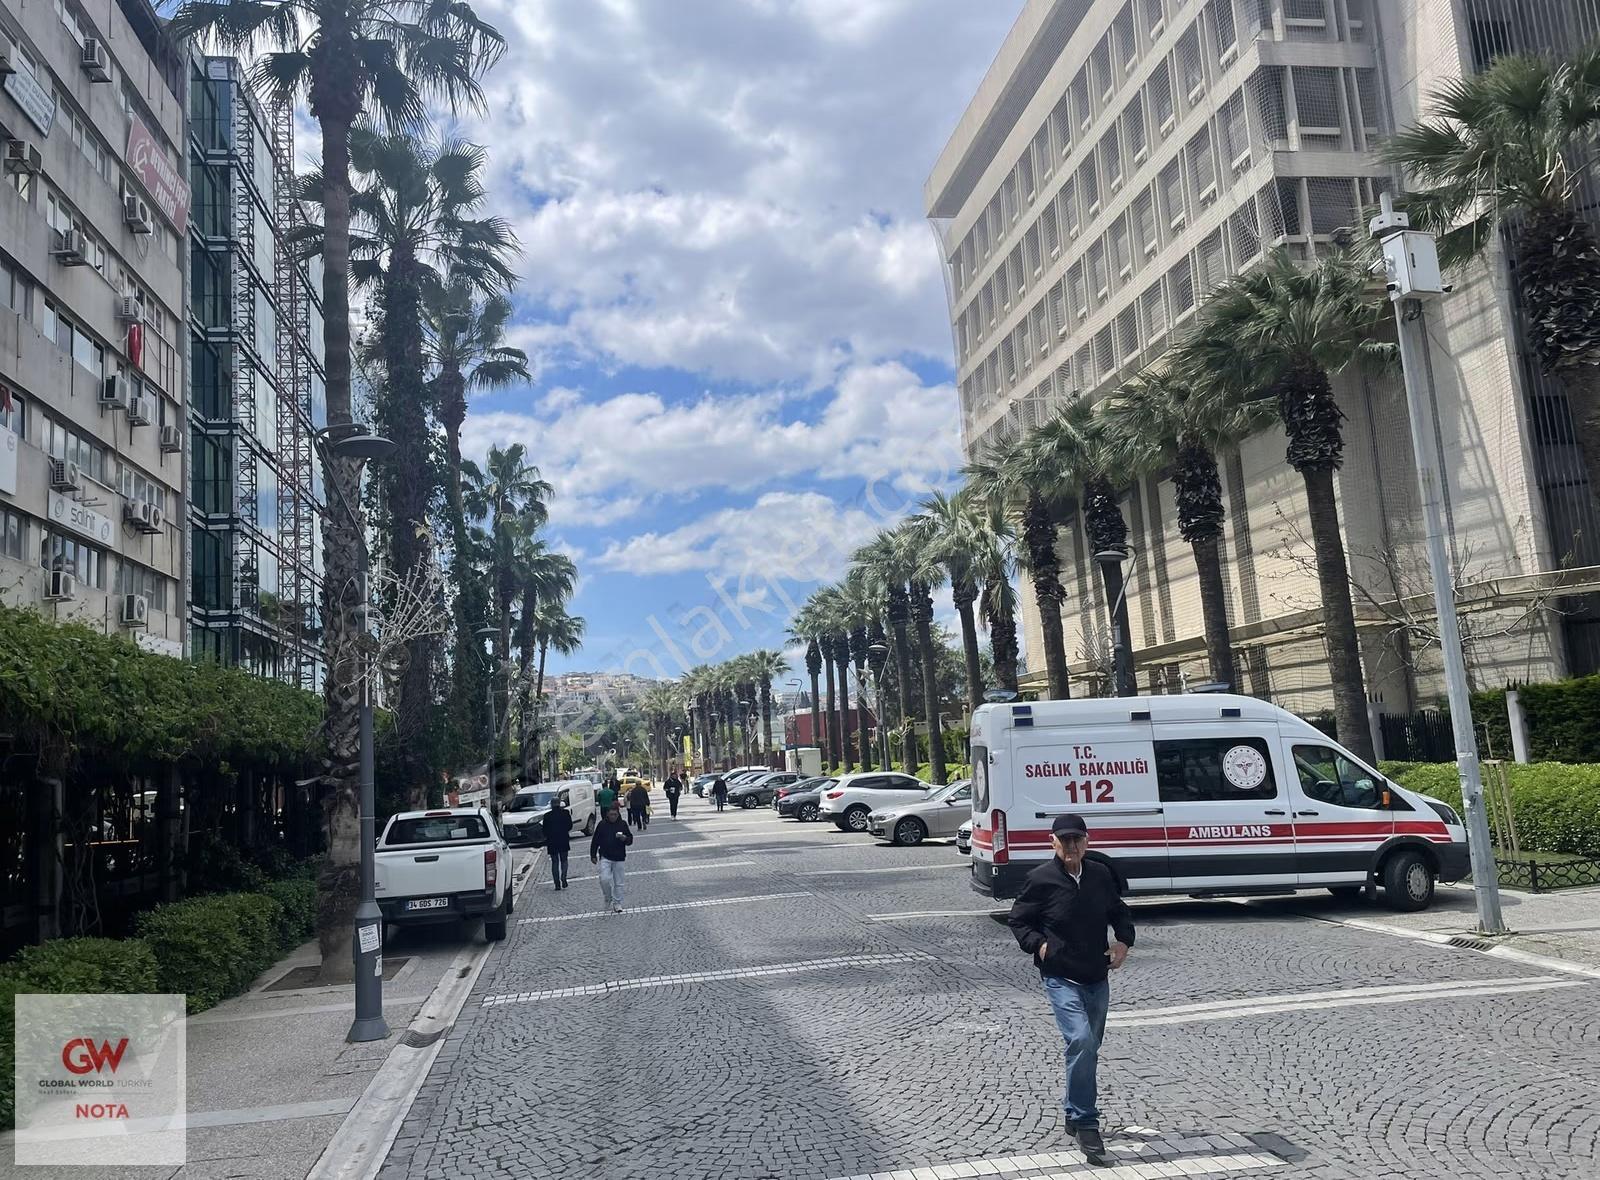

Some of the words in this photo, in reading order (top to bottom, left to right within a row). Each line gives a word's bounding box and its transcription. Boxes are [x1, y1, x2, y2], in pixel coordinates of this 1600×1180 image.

[1073, 746, 1096, 759] T.C.
[1025, 761, 1072, 778] SAĞLIK
[1079, 758, 1149, 776] BAKANLIĞI
[1065, 779, 1115, 804] 112
[1188, 825, 1272, 838] AMBULANS
